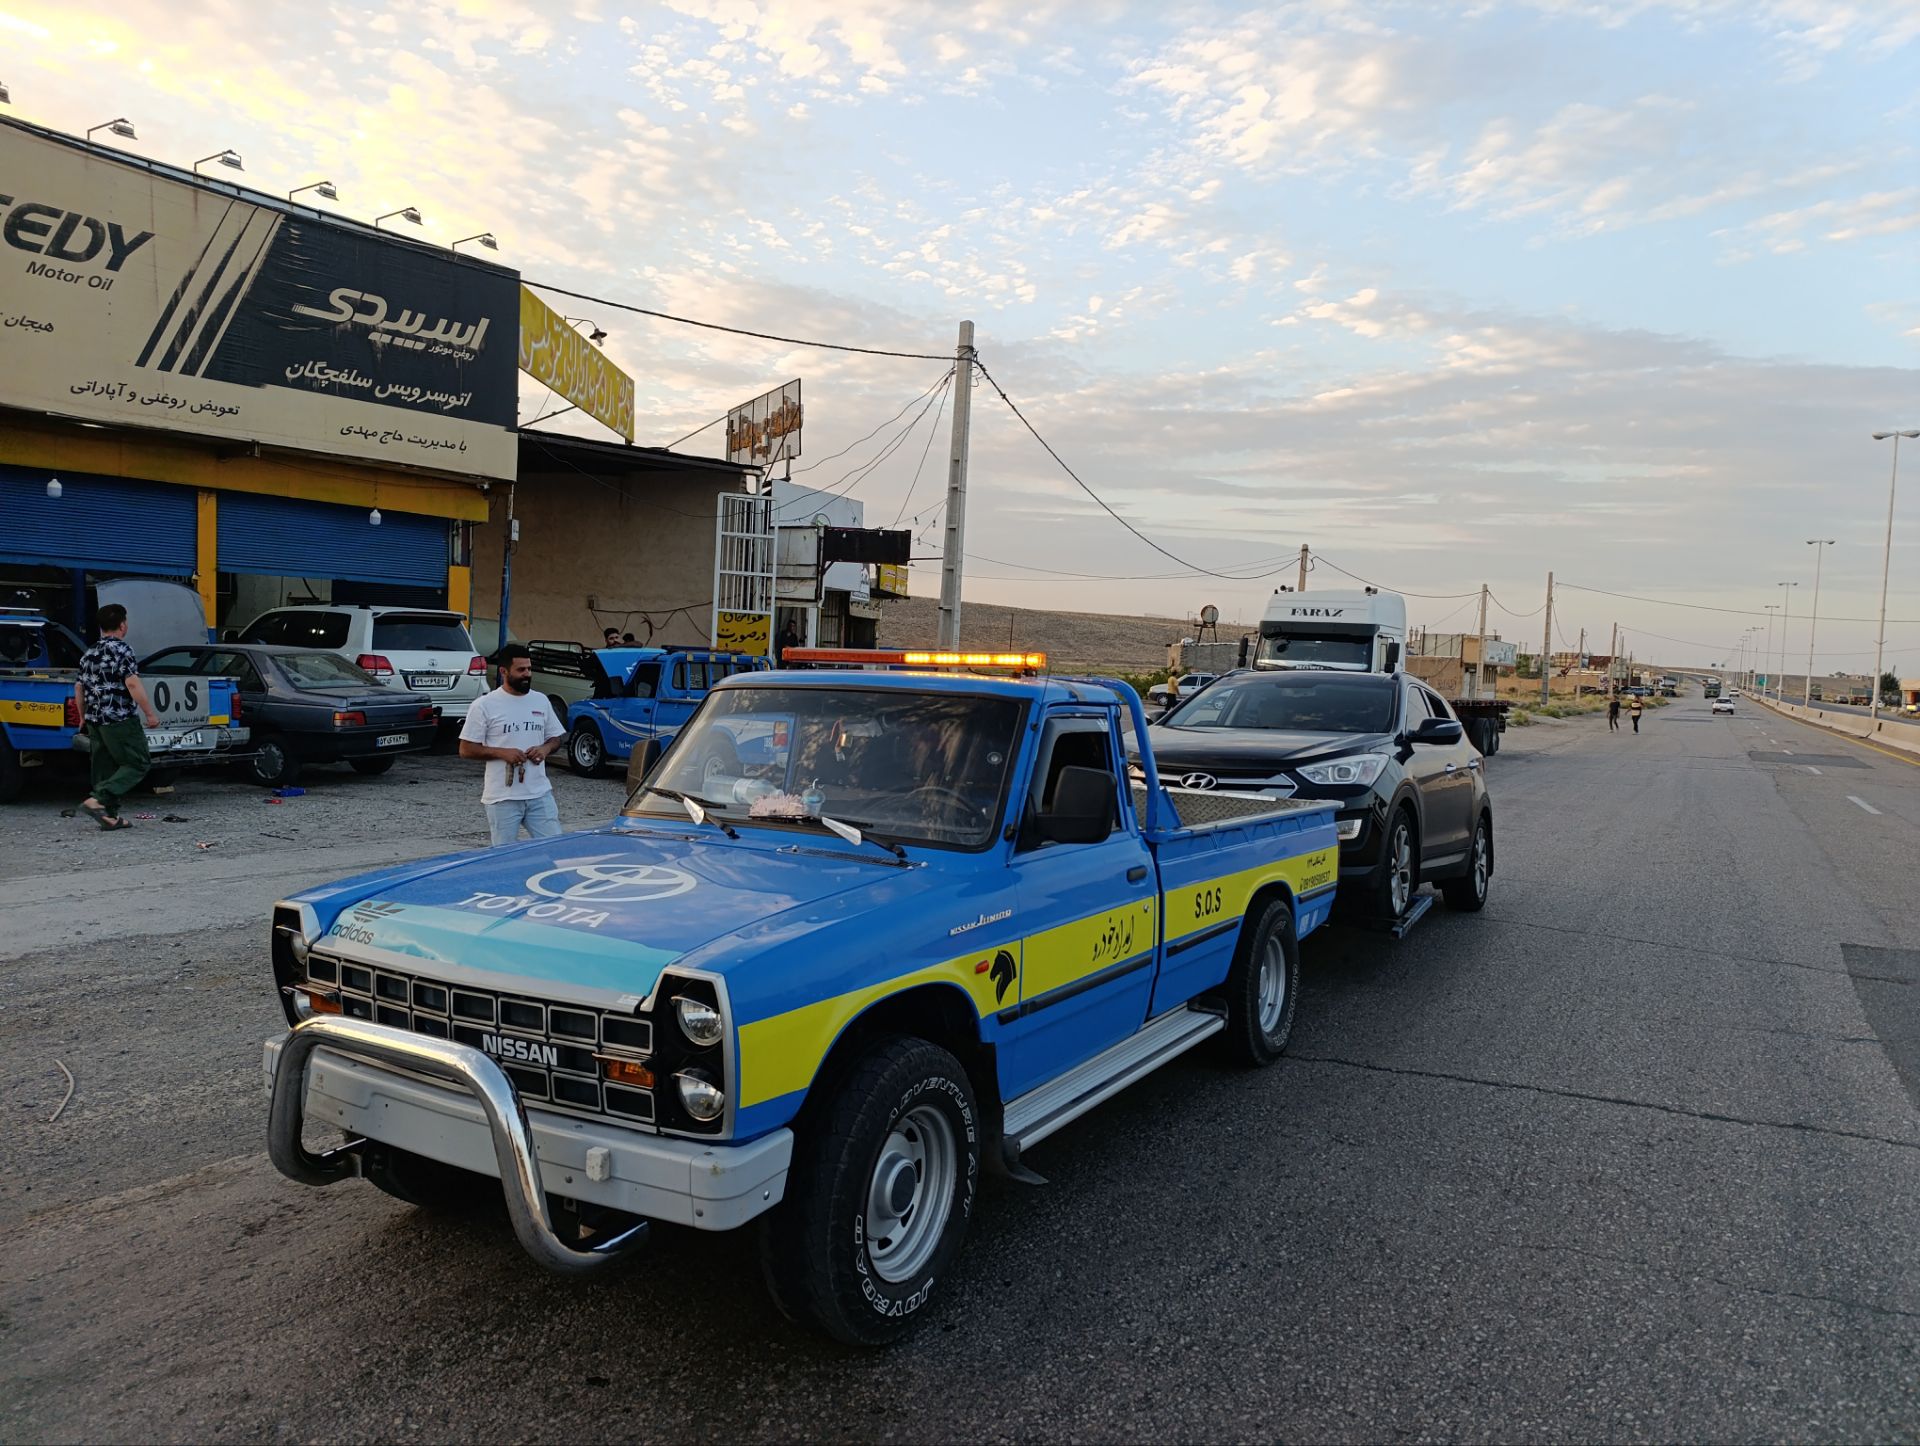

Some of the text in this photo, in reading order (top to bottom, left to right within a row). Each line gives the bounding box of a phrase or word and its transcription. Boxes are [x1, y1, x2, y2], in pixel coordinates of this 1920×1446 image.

[25, 261, 114, 291] Motor Oil
[4, 315, 54, 333] هیجان
[428, 344, 475, 361] روغن موتور
[70, 381, 241, 417] تعویض روغنی و آپاراتی
[285, 360, 472, 411] اتوسرویس سلفچگان
[340, 424, 467, 454] با مدیریت حاج مهدی
[1291, 608, 1344, 617] FARAZ
[503, 722, 520, 734] It's
[458, 892, 610, 928] TOYOTA
[1195, 887, 1221, 918] S.O.S
[331, 923, 375, 945] adidas
[482, 1033, 558, 1066] NISSAN
[854, 1214, 934, 1317] JOYROAD
